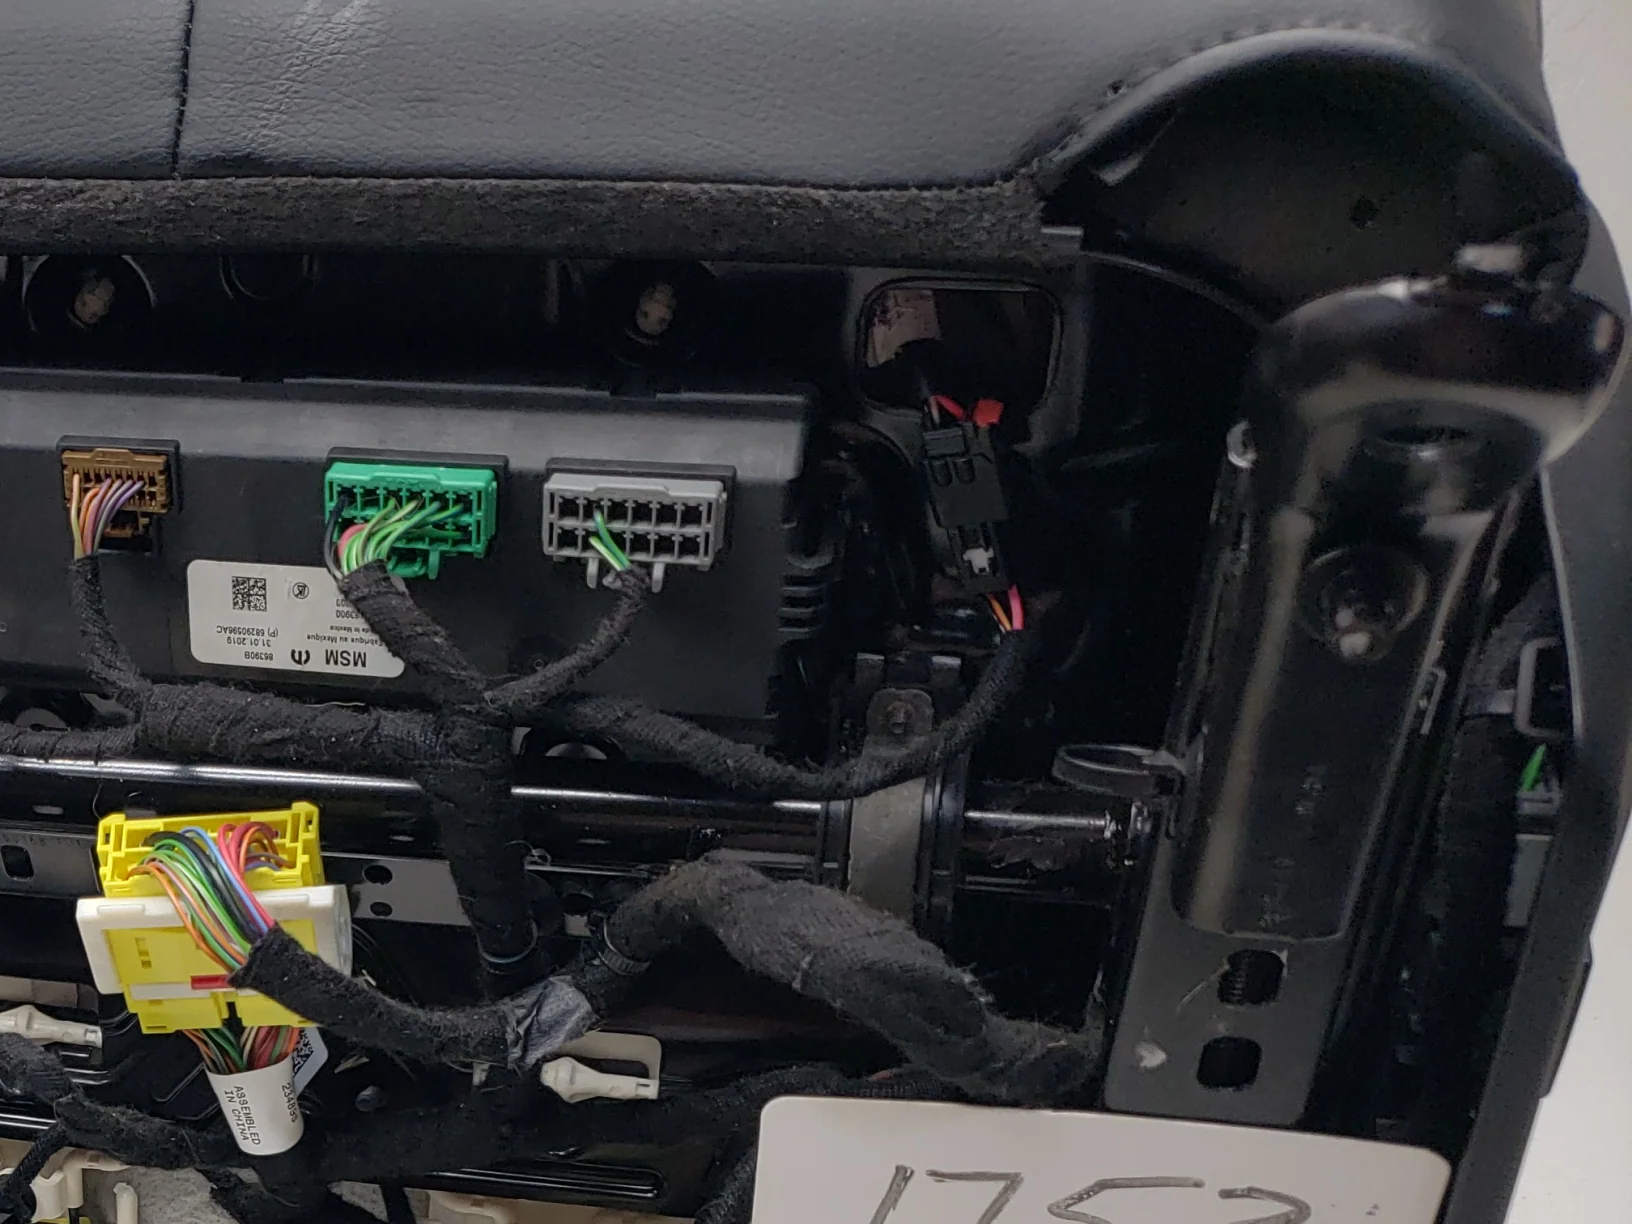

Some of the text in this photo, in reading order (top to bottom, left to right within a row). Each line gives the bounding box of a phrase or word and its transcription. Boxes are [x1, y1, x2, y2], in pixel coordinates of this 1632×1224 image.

[267, 628, 279, 638] (P)
[307, 633, 338, 644] Mexique
[227, 636, 272, 648] 31.01.2019
[325, 649, 366, 668] MSM
[224, 1090, 250, 1141] IN CHINA
[234, 1085, 262, 1146] ASSEMBLED
